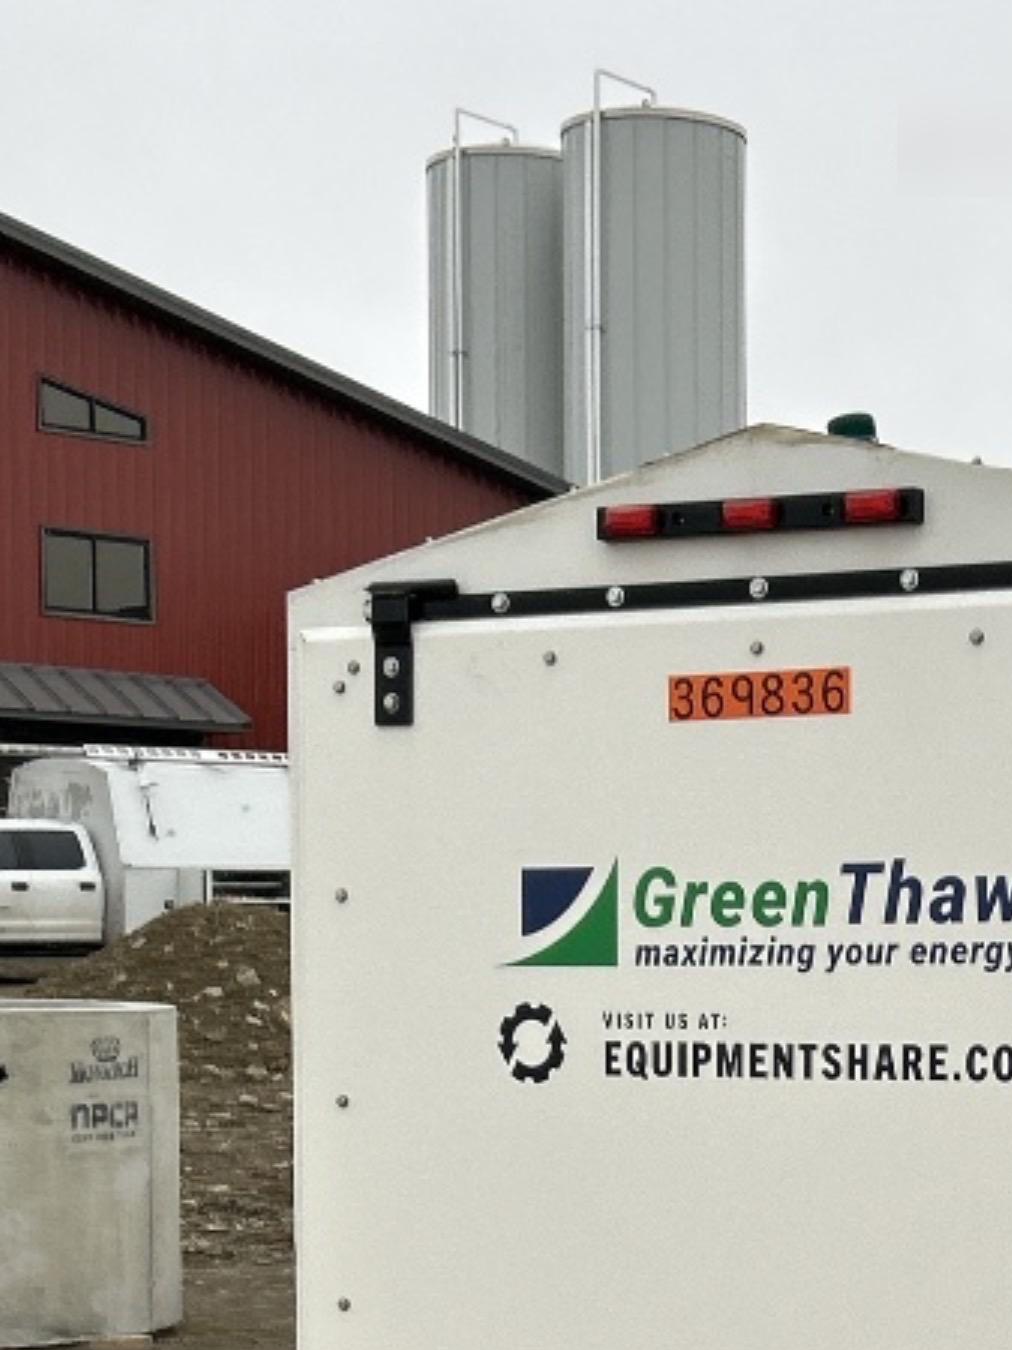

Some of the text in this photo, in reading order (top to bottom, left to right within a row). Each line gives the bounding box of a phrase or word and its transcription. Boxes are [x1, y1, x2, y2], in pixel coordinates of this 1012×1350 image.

[672, 669, 844, 721] 369836
[634, 937, 816, 973] maximizing
[825, 943, 899, 973] your
[602, 1011, 728, 1030] VISIT US AT:
